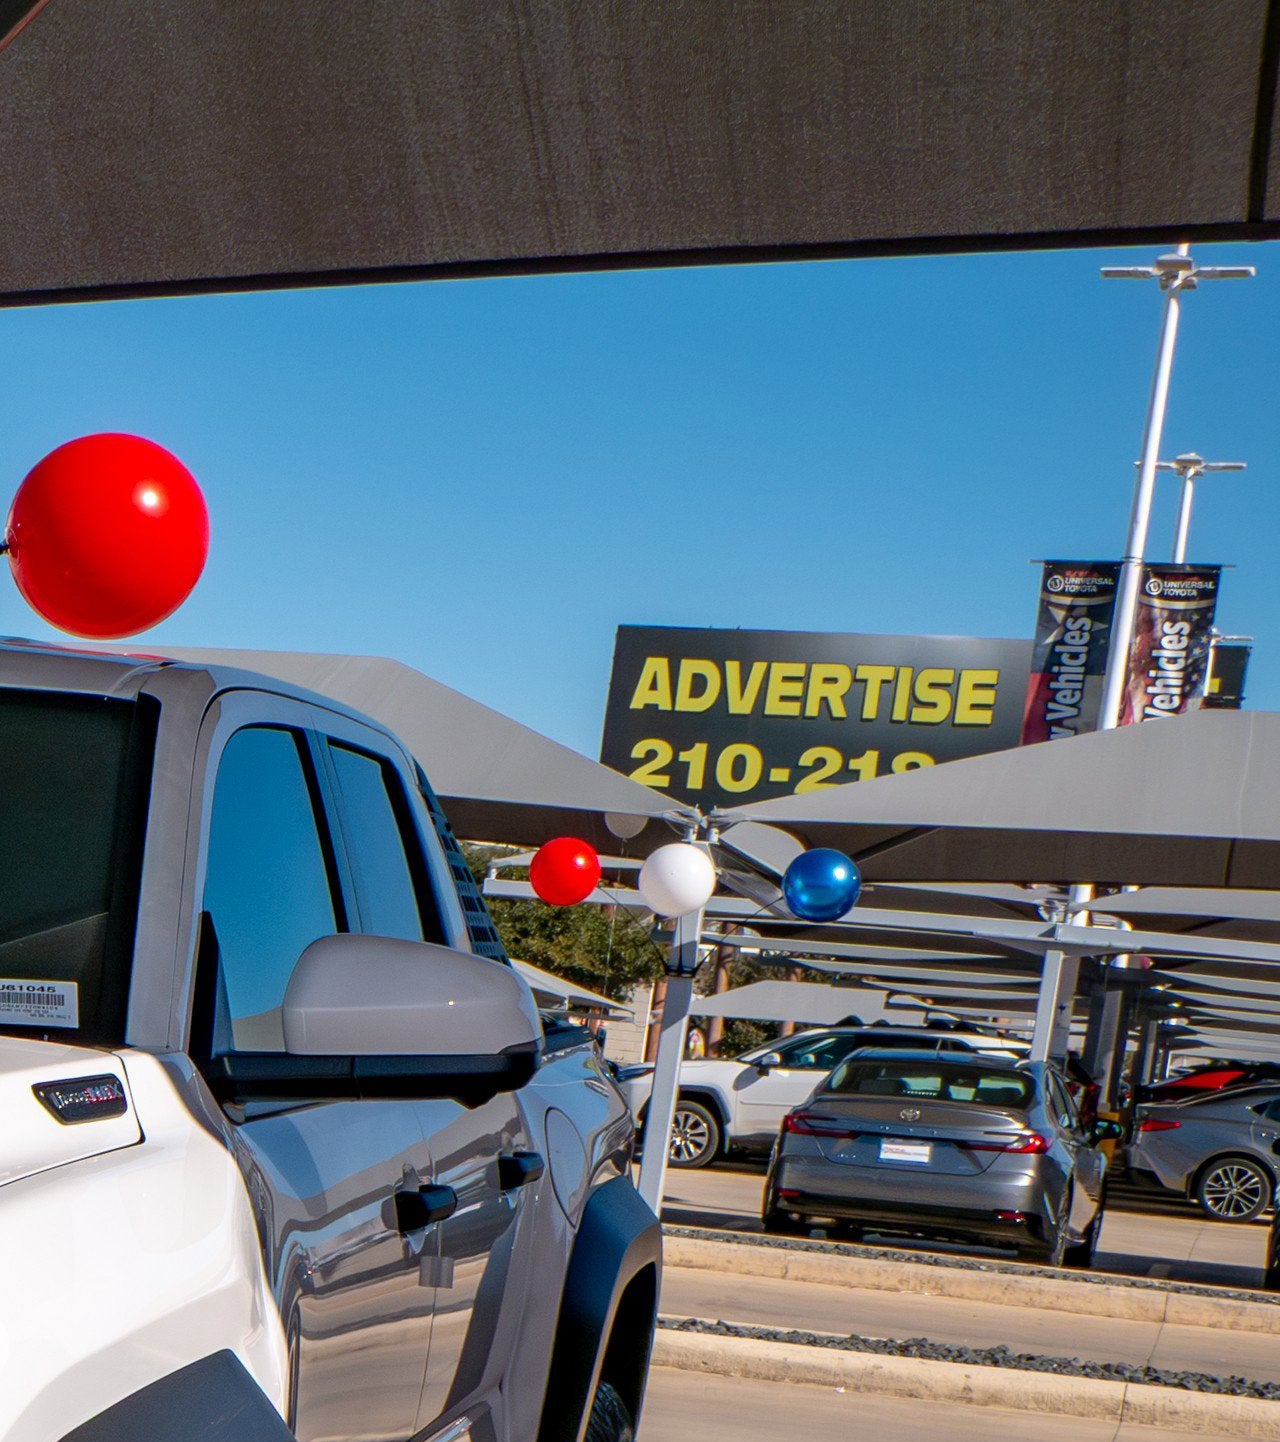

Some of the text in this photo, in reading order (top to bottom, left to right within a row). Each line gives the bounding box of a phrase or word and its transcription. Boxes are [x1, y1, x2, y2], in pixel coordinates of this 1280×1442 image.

[1064, 577, 1115, 585] UNIVERSAL
[1163, 580, 1216, 589] UNIVERSAL
[1064, 585, 1098, 593] TOYOTA
[1163, 588, 1198, 597] TOYOTA
[1045, 615, 1093, 722] Vehicles
[1143, 620, 1192, 722] Vehicles
[629, 656, 1000, 726] ADVERTISE
